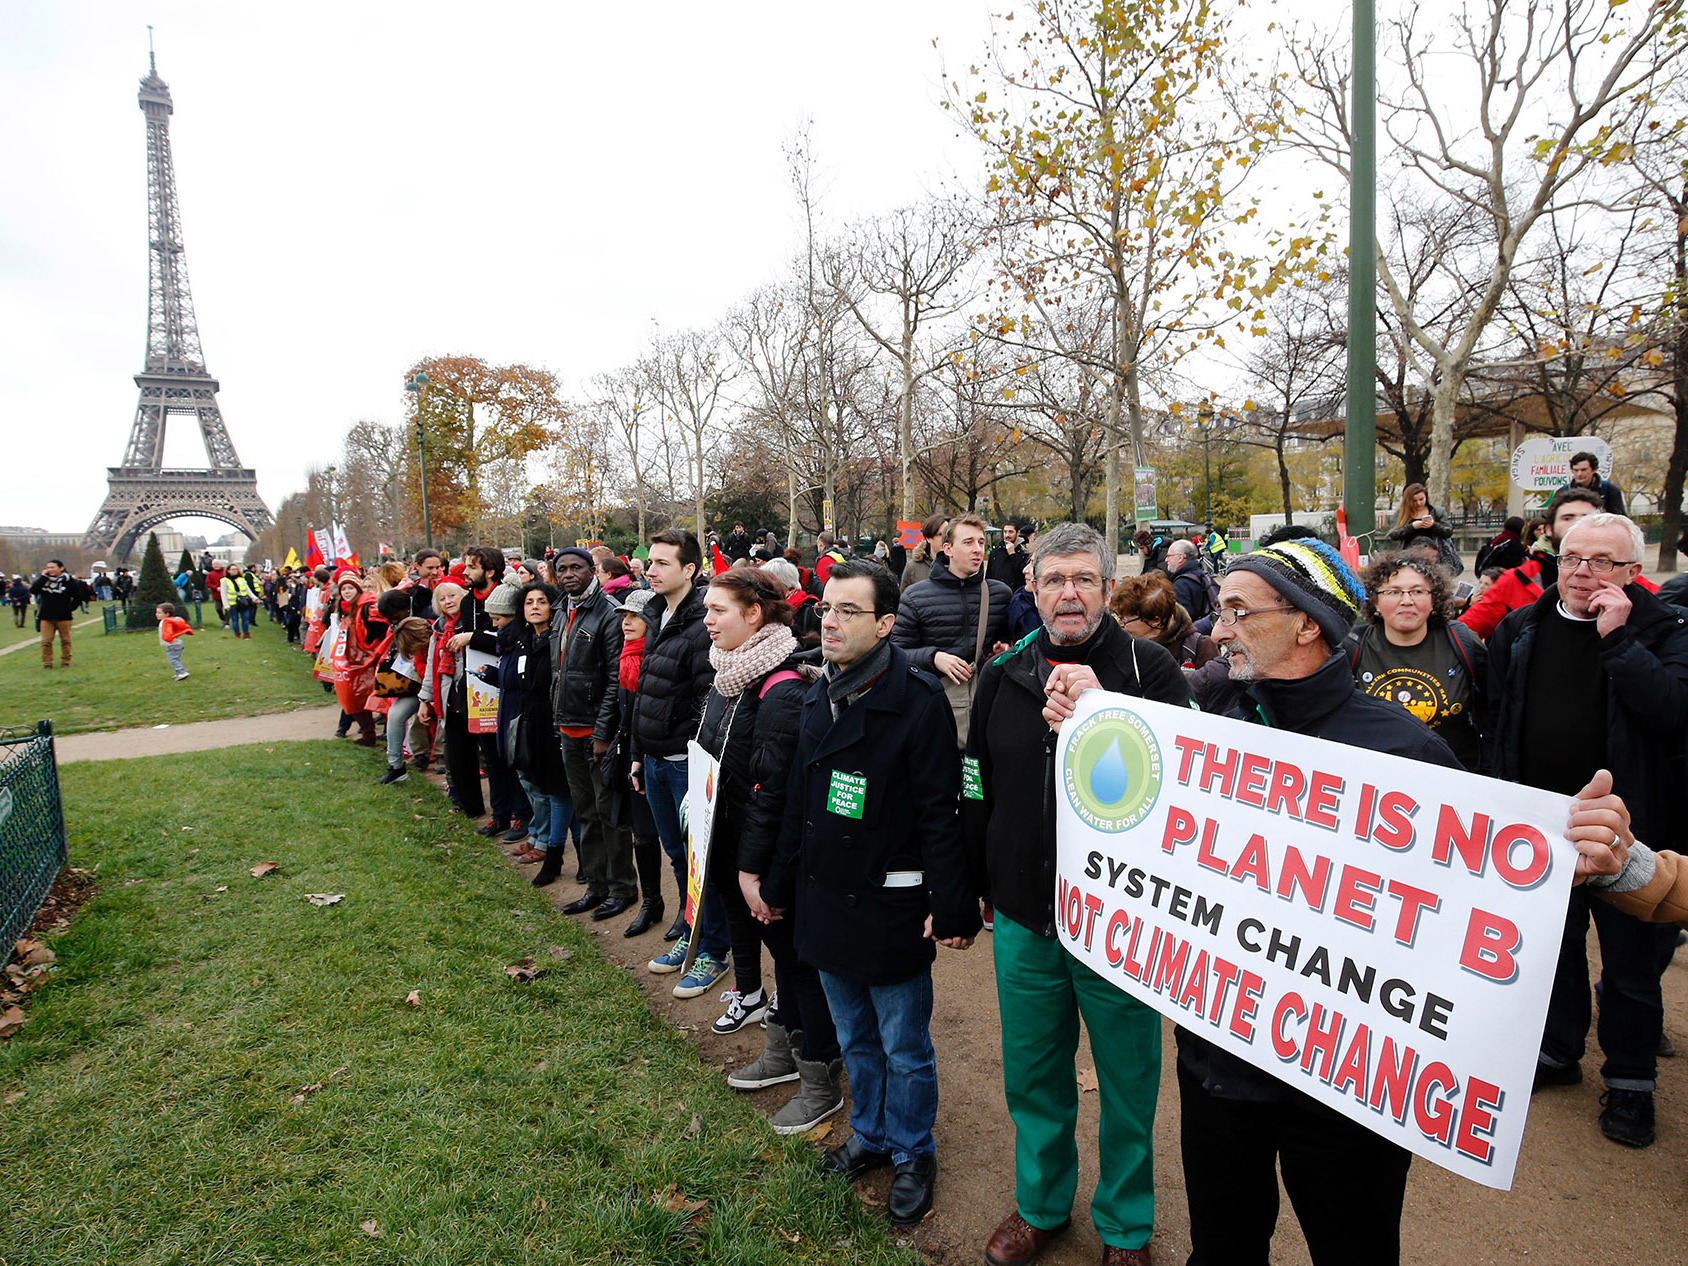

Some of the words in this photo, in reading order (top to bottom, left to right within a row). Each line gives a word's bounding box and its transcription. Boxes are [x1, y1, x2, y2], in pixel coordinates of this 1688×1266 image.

[1552, 441, 1572, 452] AVEC
[1387, 667, 1441, 688] COMMUNITIES
[1439, 688, 1449, 706] SAY
[1069, 716, 1098, 753] FRACK
[1098, 710, 1127, 722] FREE
[1127, 714, 1160, 782] SOMERSET
[831, 780, 864, 795] JUSTICE
[831, 797, 858, 810] PEACE
[832, 771, 866, 786] CLIMATE
[837, 790, 853, 801] FOR
[1065, 767, 1082, 809] CLEAN
[1080, 805, 1113, 830] WATER
[1116, 814, 1138, 830] FOR
[1138, 795, 1155, 818] ALL
[1174, 734, 1345, 830] THERE
[1355, 782, 1421, 852] IS
[1431, 803, 1553, 891] NO
[1160, 805, 1442, 949] PLANET
[1458, 906, 1523, 986] B
[1084, 850, 1225, 937] SYSTEM
[1236, 917, 1455, 1041] CHANGE
[1057, 873, 1105, 953] NOT
[1104, 908, 1267, 1045] CLIMATE
[1270, 991, 1506, 1168] CHANGE
